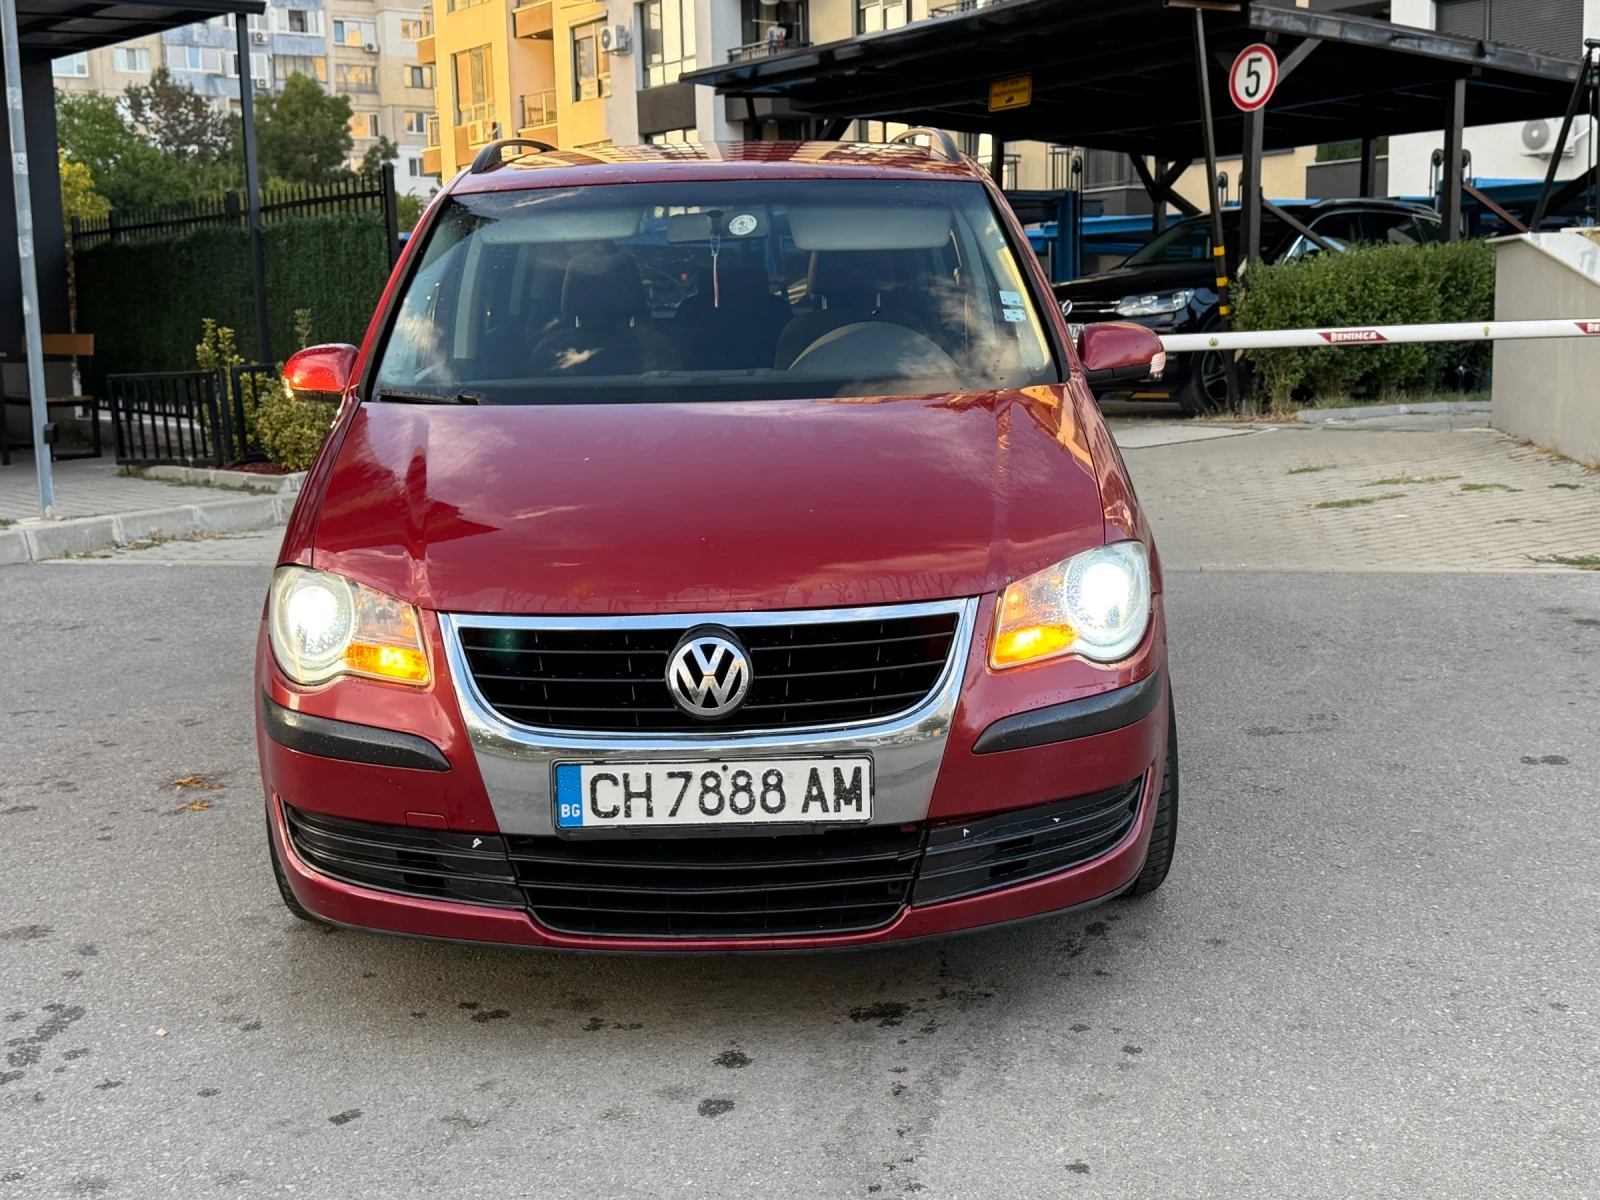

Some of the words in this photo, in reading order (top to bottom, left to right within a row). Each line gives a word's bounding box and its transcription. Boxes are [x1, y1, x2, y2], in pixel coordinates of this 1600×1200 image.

[1244, 57, 1263, 98] 5
[1330, 331, 1377, 342] BENINCA
[590, 772, 654, 819] CH
[666, 768, 787, 817] 7888
[801, 766, 863, 813] AM
[561, 803, 581, 818] BG
